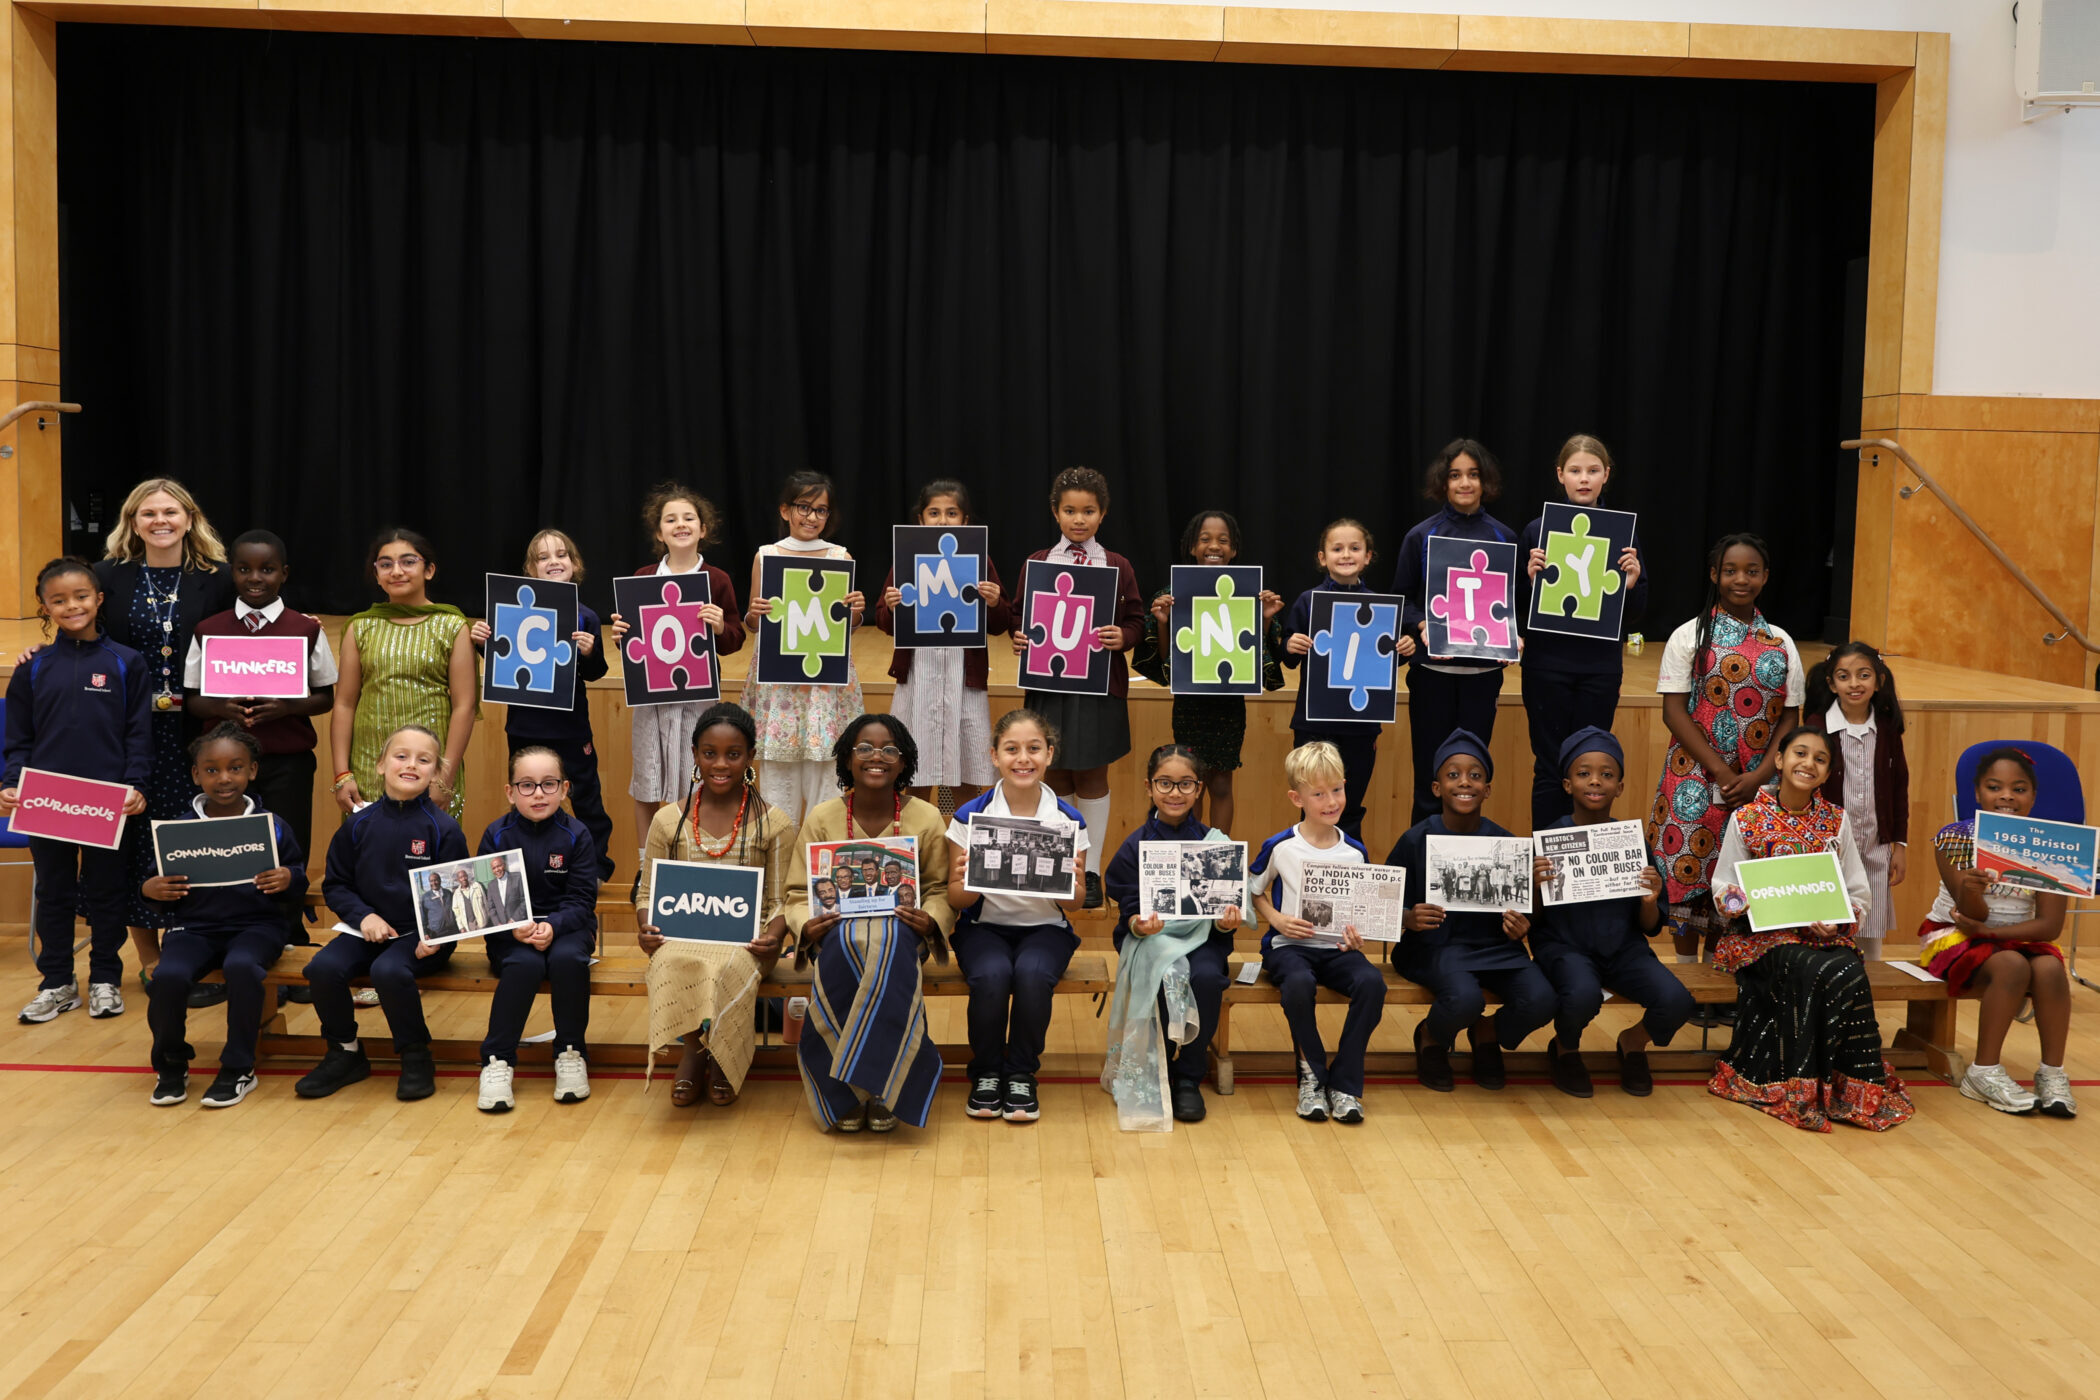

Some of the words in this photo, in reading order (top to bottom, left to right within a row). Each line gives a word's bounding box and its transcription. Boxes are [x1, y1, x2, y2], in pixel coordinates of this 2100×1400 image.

[1565, 544, 1595, 597] Y
[918, 559, 958, 607] M
[1456, 577, 1482, 621] T
[787, 597, 830, 650] M
[1051, 600, 1087, 651] U
[1201, 603, 1235, 656] N
[517, 615, 550, 664] C
[652, 614, 686, 664] O
[210, 659, 297, 675] THINKERS
[1343, 632, 1360, 681] I
[23, 797, 116, 821] COURAGEOUS
[1545, 834, 1575, 844] BRISTOL'S
[1561, 841, 1587, 850] CITIZENS
[1993, 832, 2027, 844] 1963
[2032, 837, 2080, 851] Bristol
[166, 843, 265, 861] COMMUNICATORS
[1568, 855, 1580, 866] NO
[1586, 851, 1620, 865] COLOUR
[1625, 848, 1643, 860] BAR
[1992, 844, 2017, 855] Bus
[2022, 848, 2079, 863] Boycott
[1322, 870, 1365, 879] INDIANS
[1371, 873, 1388, 881] 100
[1573, 867, 1585, 878] ON
[1590, 864, 1608, 877] OUR
[1614, 861, 1642, 874] BUSES
[1304, 886, 1350, 895] BOYCOTT
[1306, 877, 1324, 885] FOR
[1331, 879, 1350, 887] BUS
[657, 892, 749, 918] CARING
